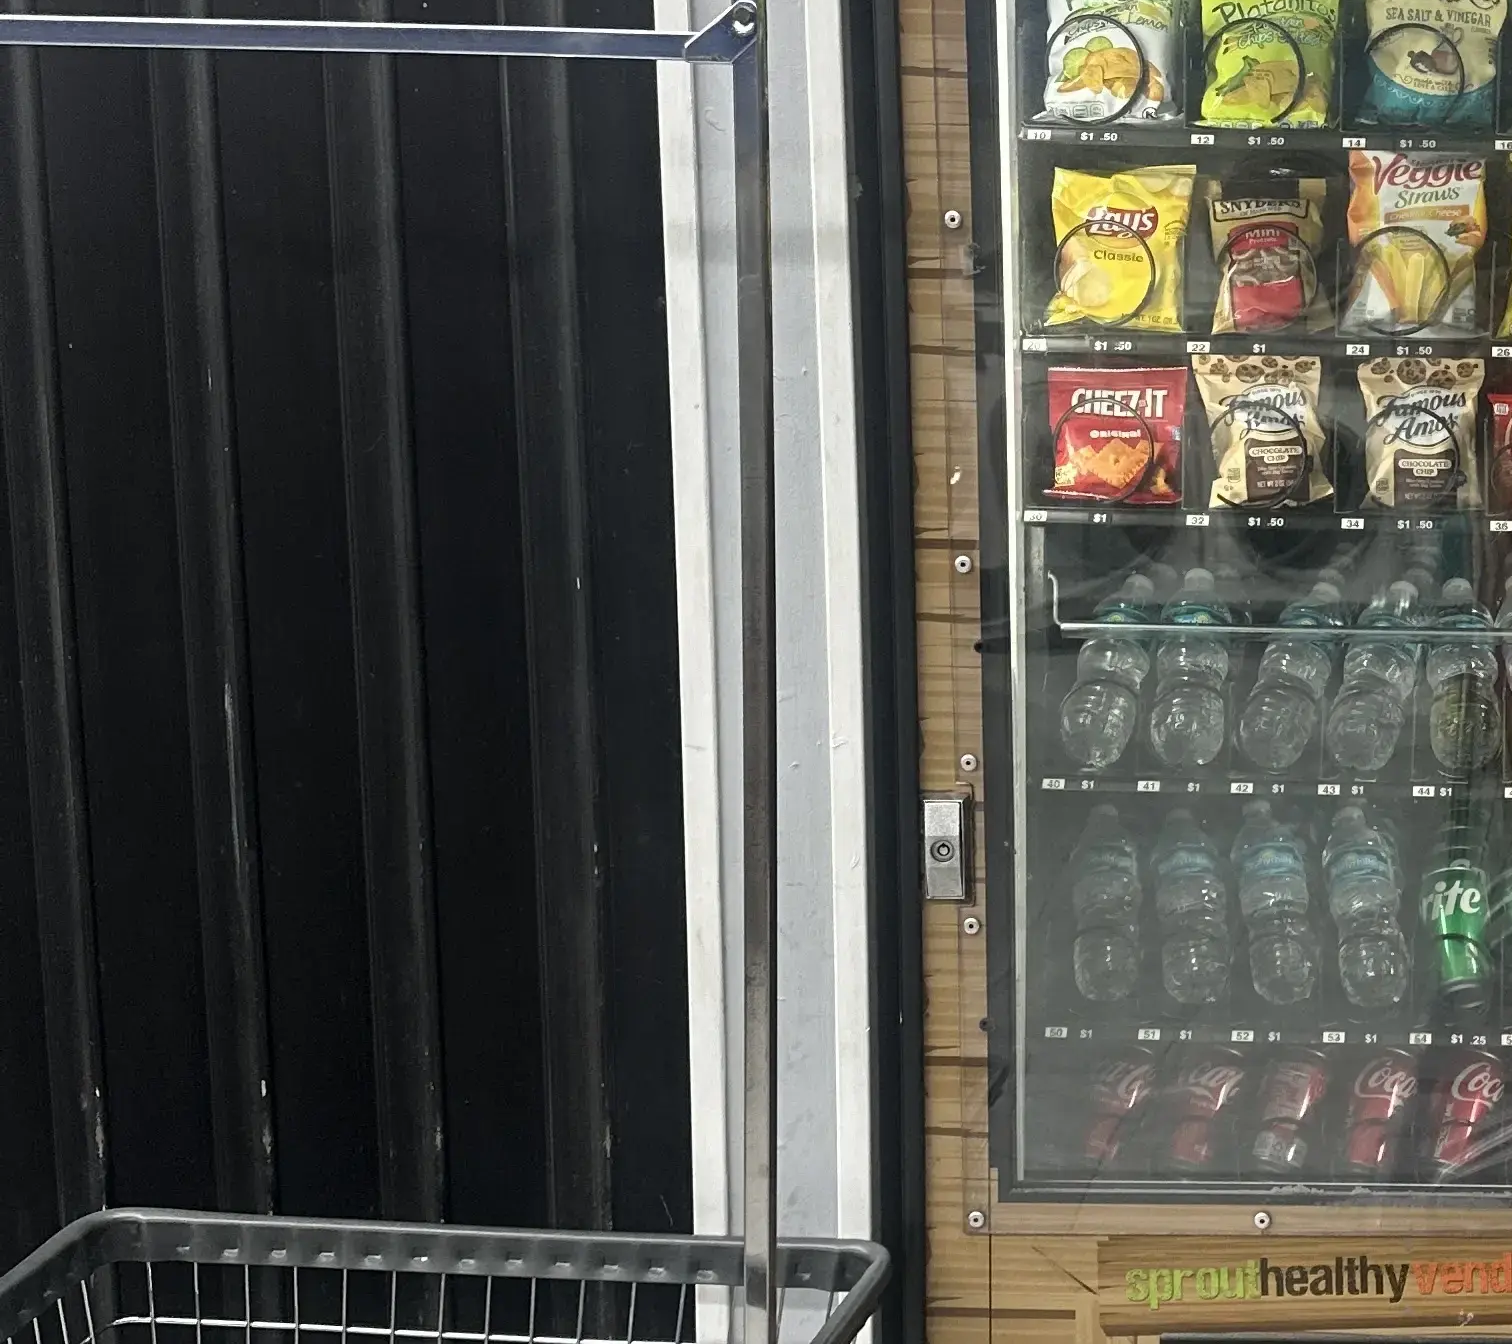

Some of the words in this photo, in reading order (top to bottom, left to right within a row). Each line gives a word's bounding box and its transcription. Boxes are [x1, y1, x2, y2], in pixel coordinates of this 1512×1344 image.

[1385, 6, 1405, 21] SEA
[1407, 7, 1431, 22] SALT
[1447, 9, 1491, 27] VINEGAR
[1372, 152, 1483, 195] Veggie
[1395, 186, 1461, 209] Straws
[1093, 249, 1144, 263] Classic
[1192, 344, 1206, 352] 22
[1351, 346, 1364, 354] 24
[1496, 348, 1511, 356] 26
[1071, 388, 1168, 418] CHEEZ-IT
[1401, 460, 1450, 468] CHOCOLATE
[1346, 519, 1360, 528] 34
[1495, 522, 1509, 531] 36
[1047, 779, 1061, 789] 40
[1142, 782, 1155, 791] 41
[1235, 784, 1249, 793] 42
[1322, 786, 1336, 795] 43
[1418, 787, 1431, 795] 44
[1143, 1030, 1156, 1039] 51
[1236, 1031, 1250, 1041] 52
